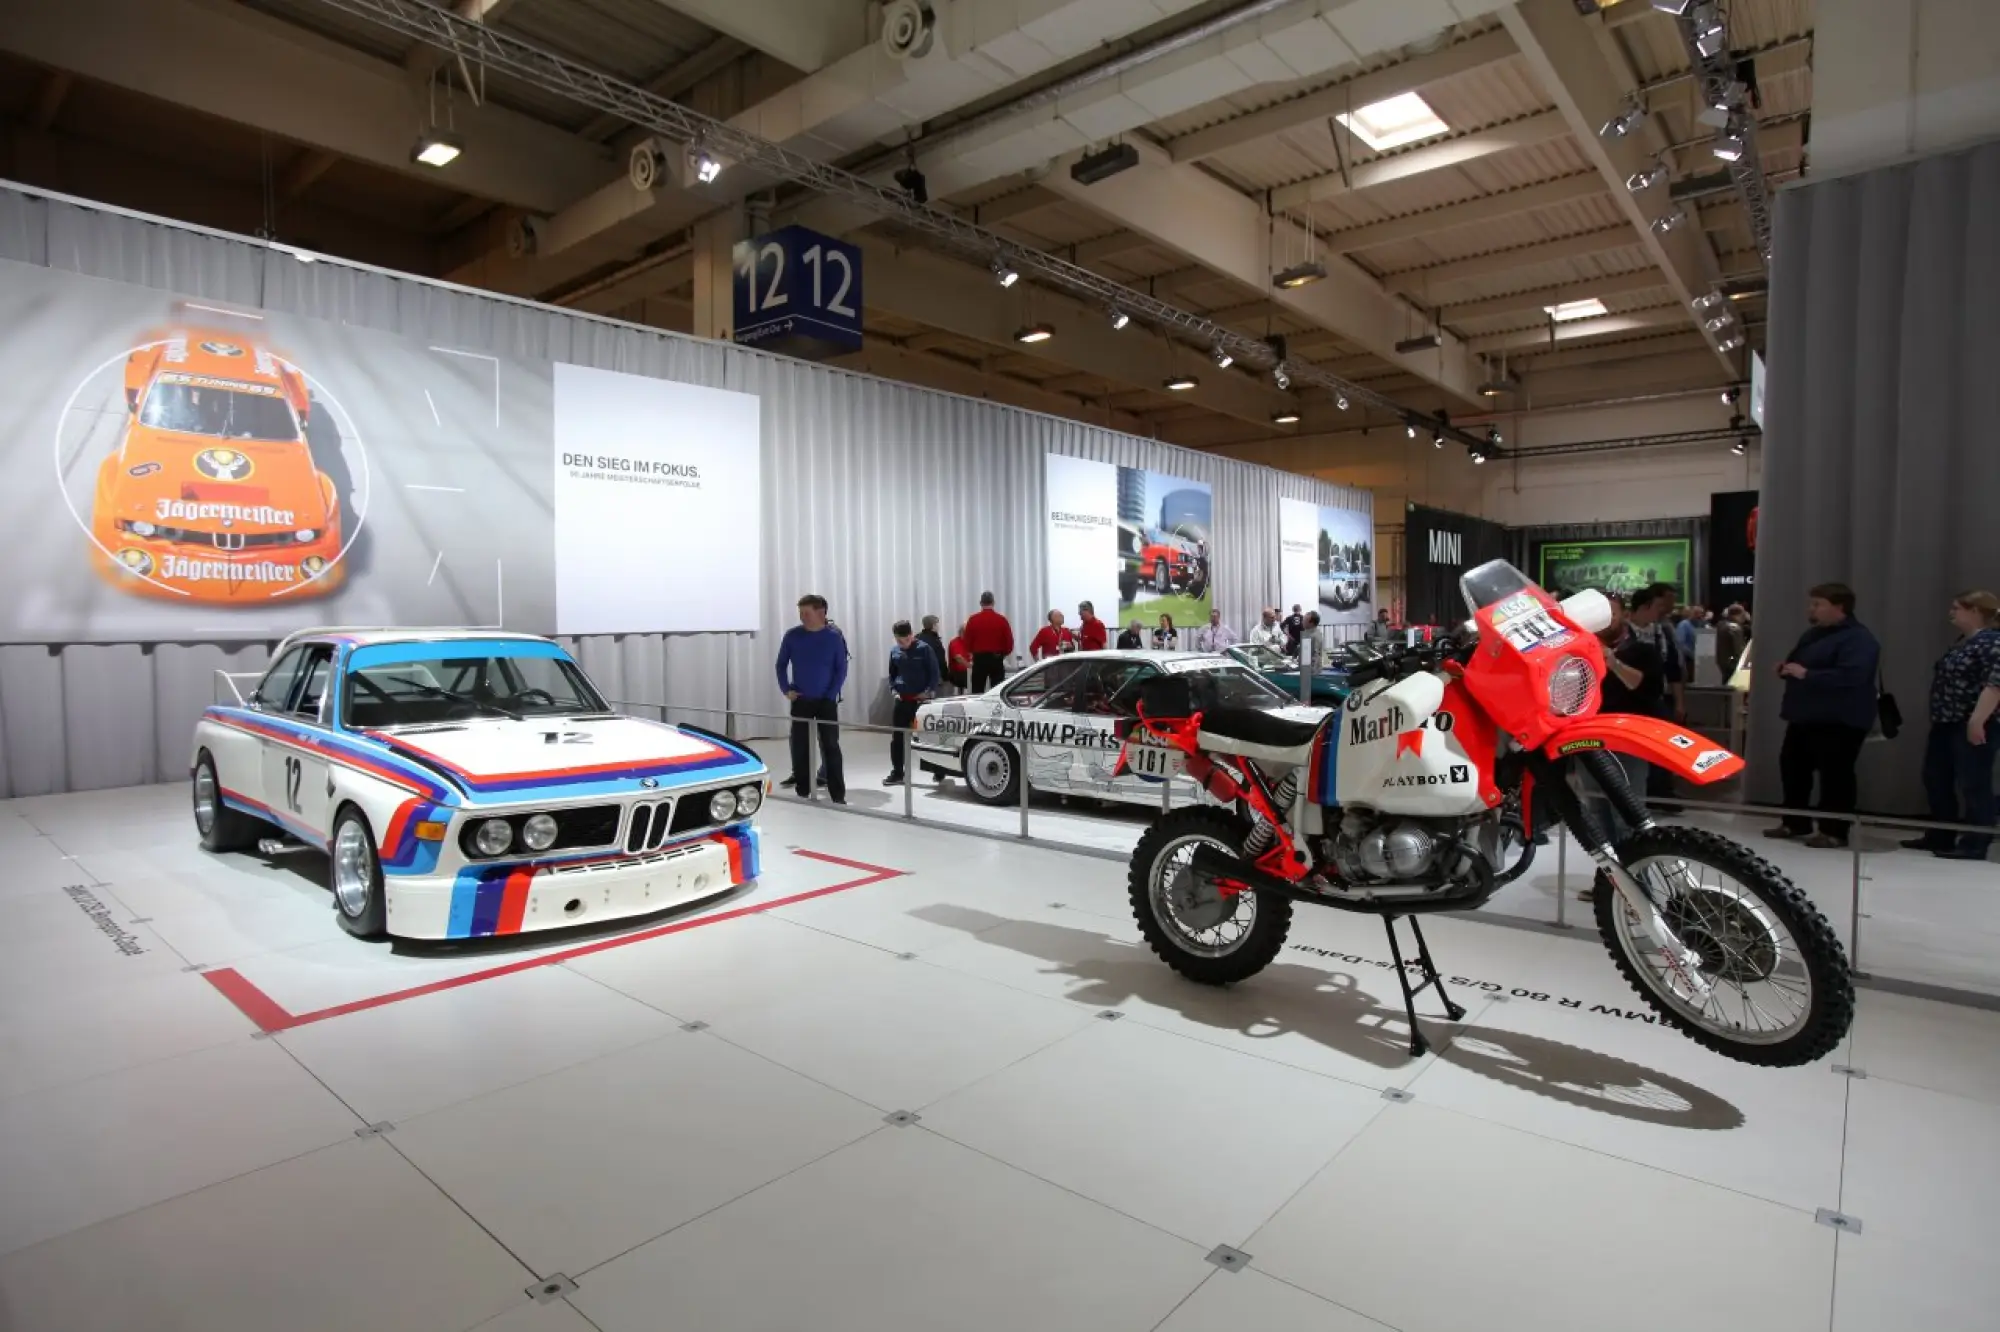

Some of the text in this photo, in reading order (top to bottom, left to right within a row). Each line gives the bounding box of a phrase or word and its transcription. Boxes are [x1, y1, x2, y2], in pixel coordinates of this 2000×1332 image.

[739, 242, 789, 313] 12
[803, 244, 855, 318] 12
[562, 452, 701, 478] DEN SIEG IM FOKUS.
[1429, 529, 1462, 565] MINI
[1721, 575, 1745, 585] MINI
[538, 731, 594, 744] 12
[1001, 719, 1057, 742] BMW
[1060, 724, 1120, 748] Parts
[1138, 748, 1167, 774] 101
[285, 756, 302, 814] 12
[1448, 975, 1503, 993] G/S
[1510, 987, 1552, 1002] 80
[1557, 996, 1583, 1009] R
